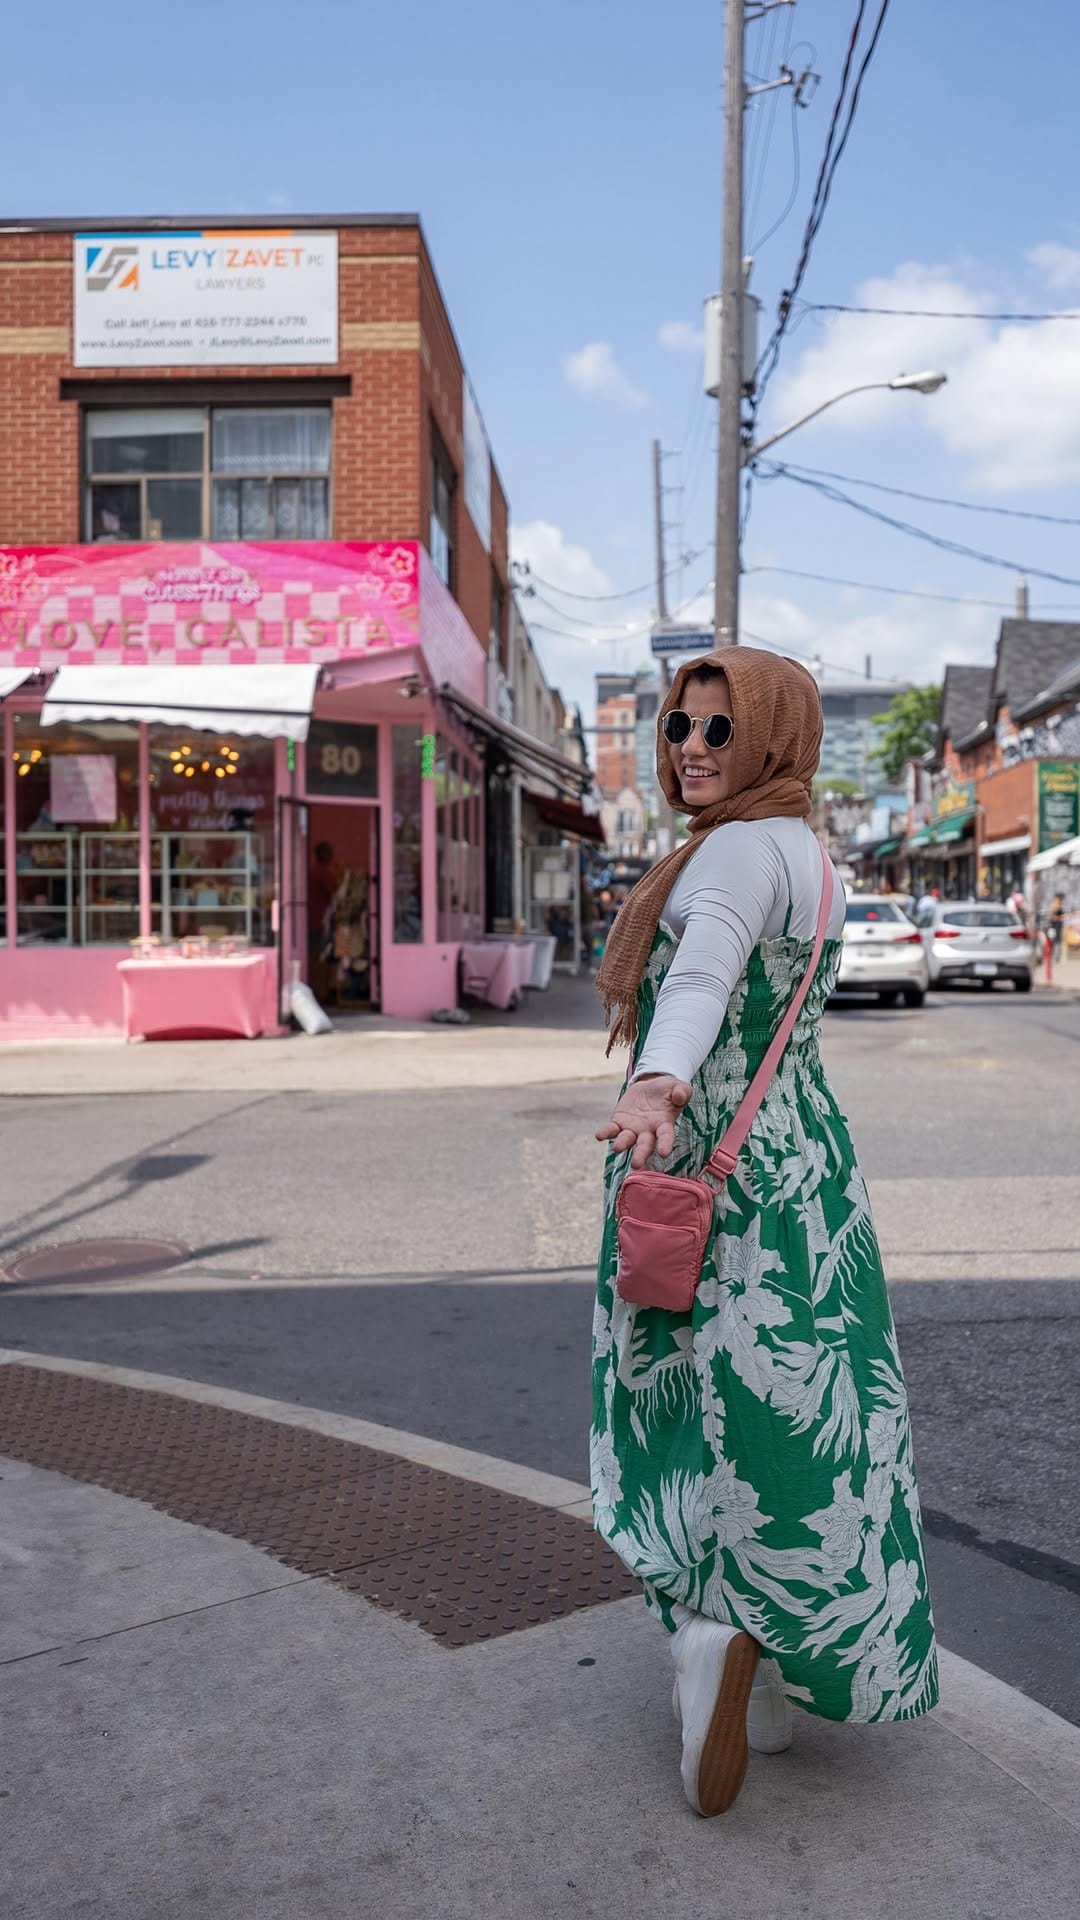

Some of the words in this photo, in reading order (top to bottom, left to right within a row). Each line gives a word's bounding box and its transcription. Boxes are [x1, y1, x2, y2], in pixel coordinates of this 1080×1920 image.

[152, 250, 217, 269] LEVY
[226, 249, 304, 268] ZAVET
[196, 277, 265, 291] LAWYERS
[17, 617, 161, 654] LOVE,
[185, 615, 394, 648] CALISTA
[321, 743, 361, 775] 80
